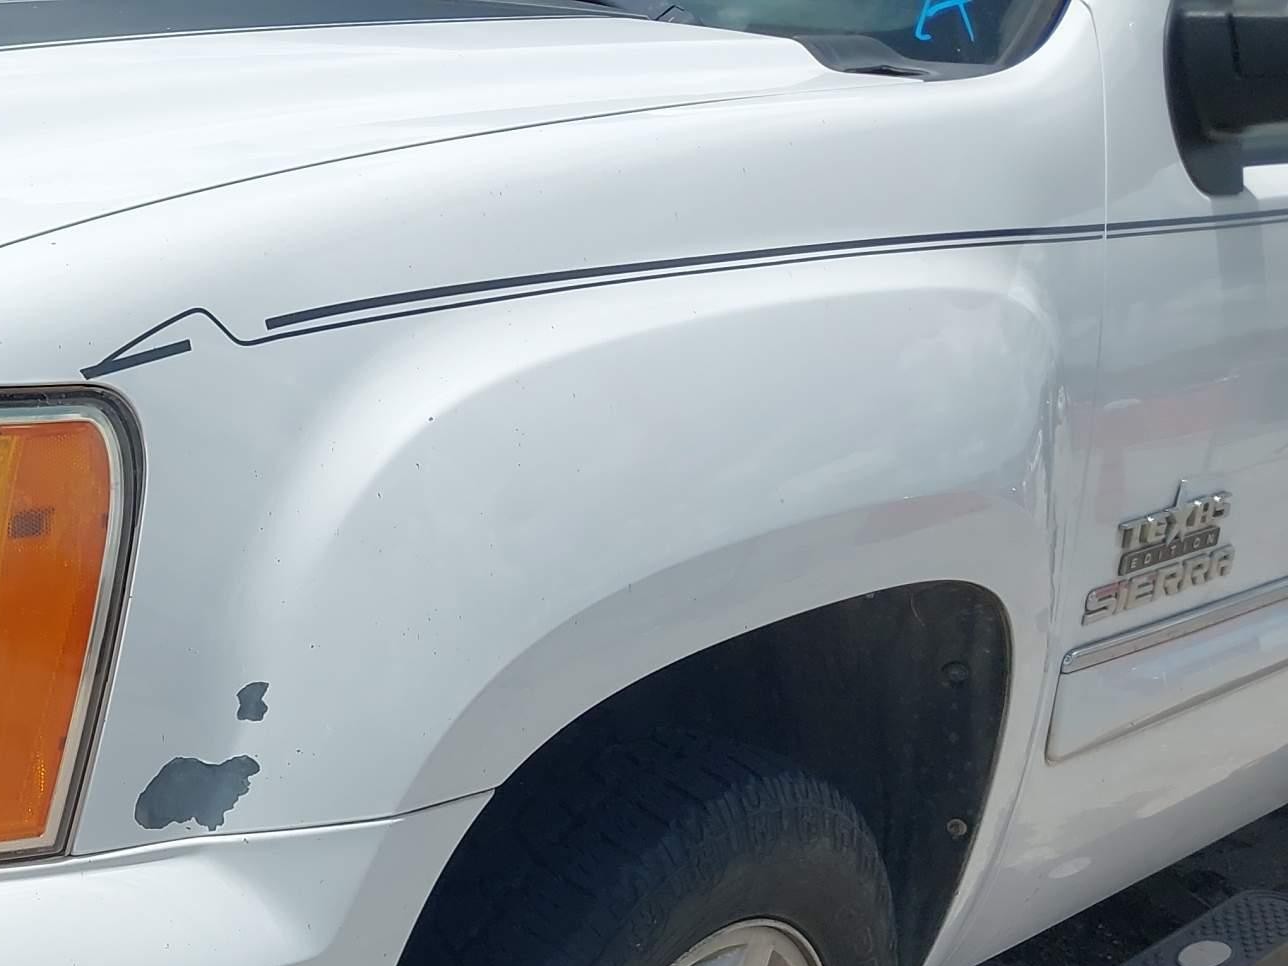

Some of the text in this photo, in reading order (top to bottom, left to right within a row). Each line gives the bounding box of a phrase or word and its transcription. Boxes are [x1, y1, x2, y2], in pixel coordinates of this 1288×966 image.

[1117, 489, 1232, 550] TEXAS
[1129, 533, 1218, 570] EDITION
[1081, 543, 1235, 627] SIERRA
